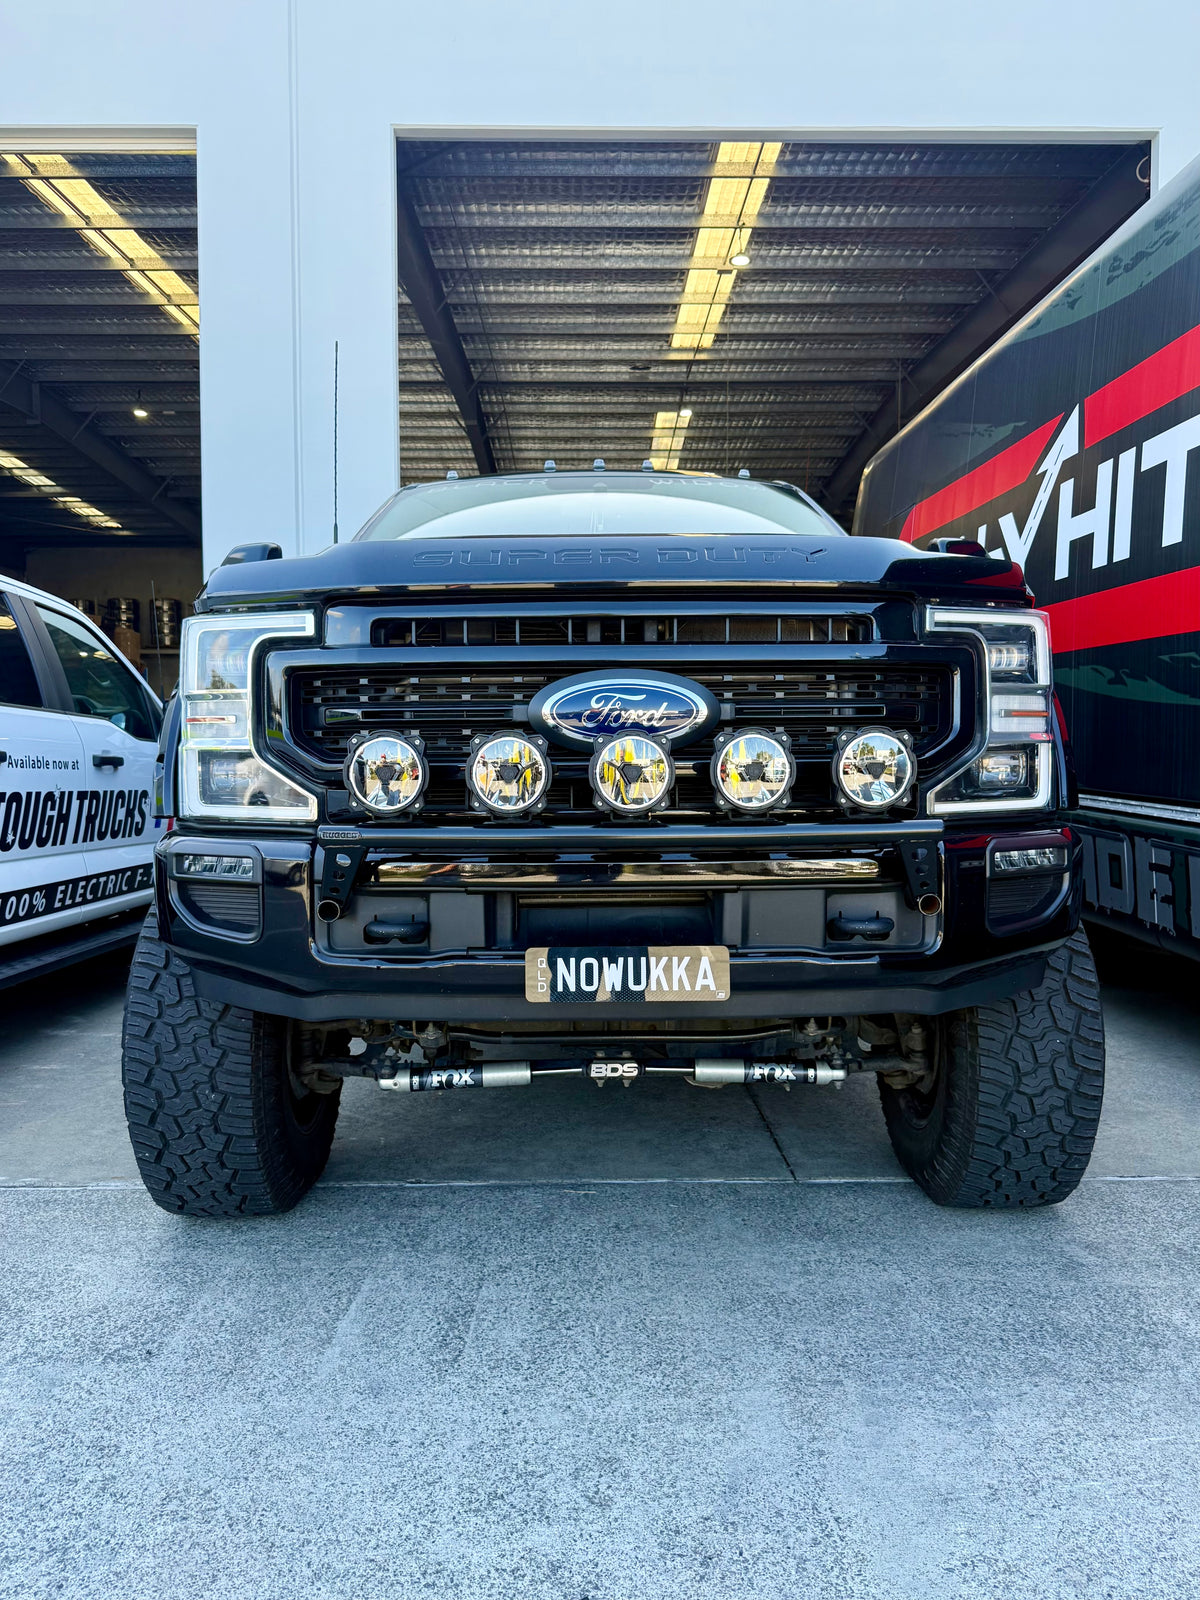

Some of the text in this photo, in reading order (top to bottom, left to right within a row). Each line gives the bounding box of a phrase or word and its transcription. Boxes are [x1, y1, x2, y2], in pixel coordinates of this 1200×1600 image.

[413, 547, 828, 567] SUPER DUTY
[582, 693, 668, 728] Ford
[7, 755, 80, 770] Available now at
[72, 789, 149, 844] TRUCKS
[0, 889, 46, 920] 00%
[53, 871, 131, 908] ELECTRIC
[537, 957, 547, 993] QLD
[556, 956, 717, 992] NOWUKKA
[430, 1068, 475, 1090] FOX
[590, 1063, 639, 1077] BDS
[752, 1062, 797, 1084] FOX
